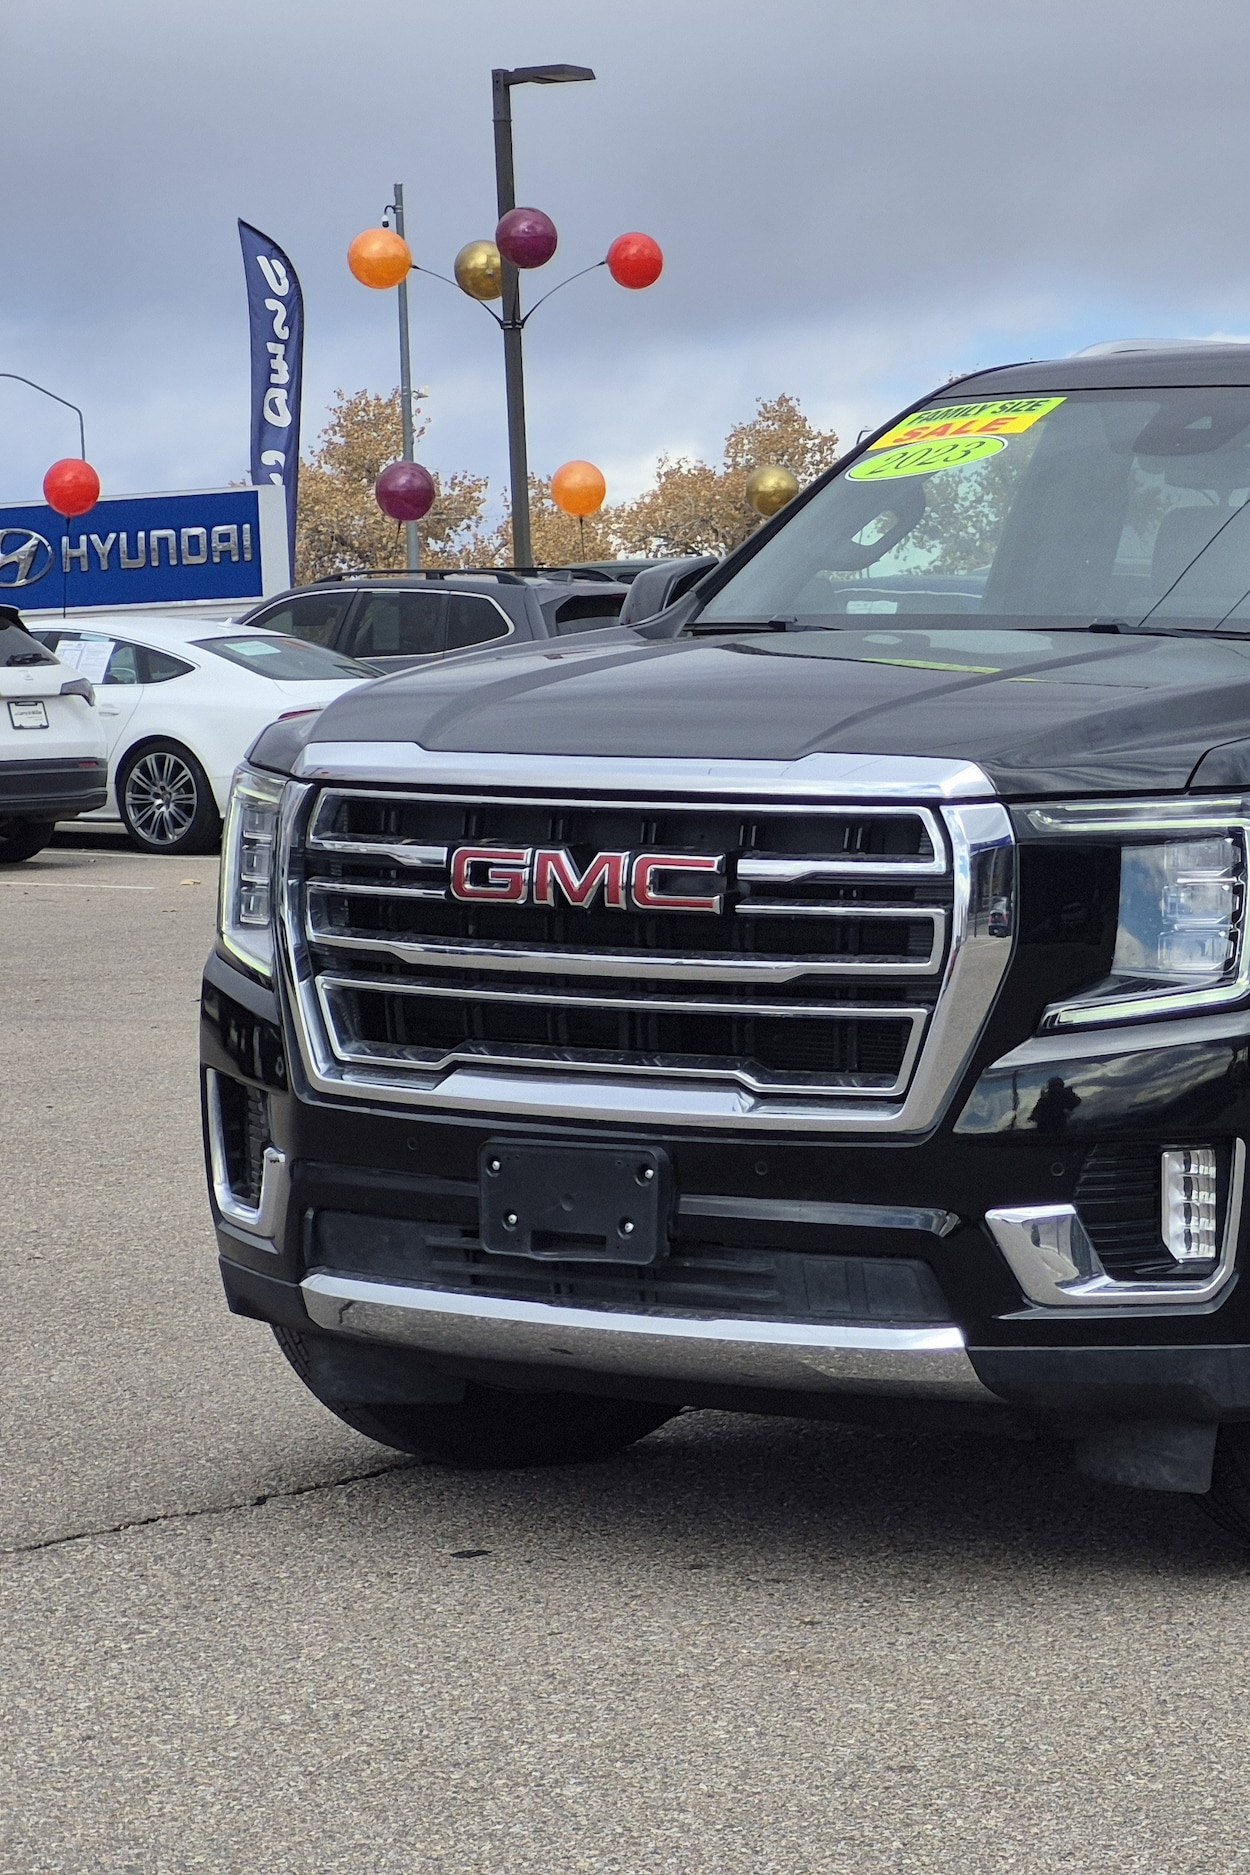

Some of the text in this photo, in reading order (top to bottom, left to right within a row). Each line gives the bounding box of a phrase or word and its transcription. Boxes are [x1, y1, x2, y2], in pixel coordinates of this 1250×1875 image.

[893, 416, 1018, 444] SALE
[908, 399, 1050, 426] FAMILY SIZE
[866, 440, 986, 475] 2023
[61, 523, 252, 573] HYUNDAI
[450, 846, 725, 916] GMC
